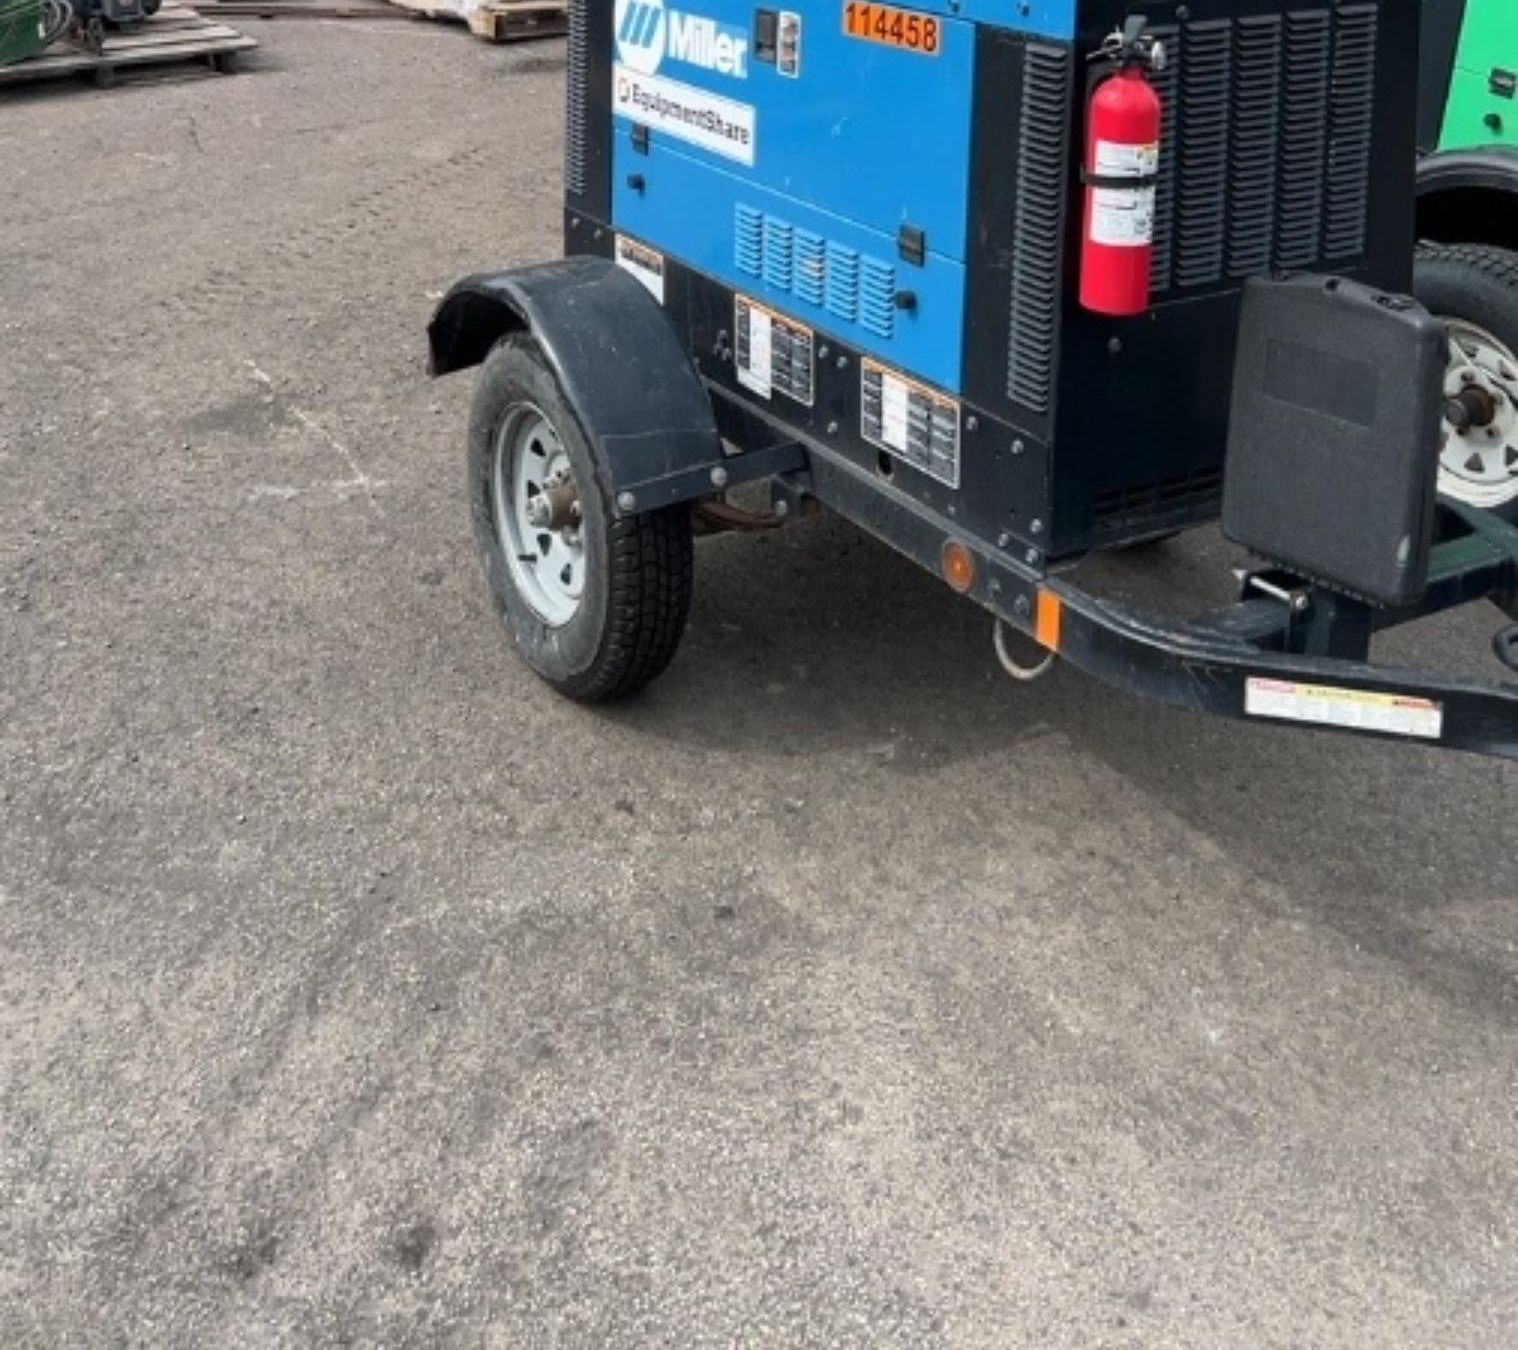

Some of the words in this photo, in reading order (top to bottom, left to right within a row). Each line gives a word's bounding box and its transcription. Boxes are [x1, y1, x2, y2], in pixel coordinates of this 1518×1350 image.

[668, 8, 748, 80] Miller
[846, 1, 937, 52] 114458
[632, 82, 751, 146] EquipmentShare
